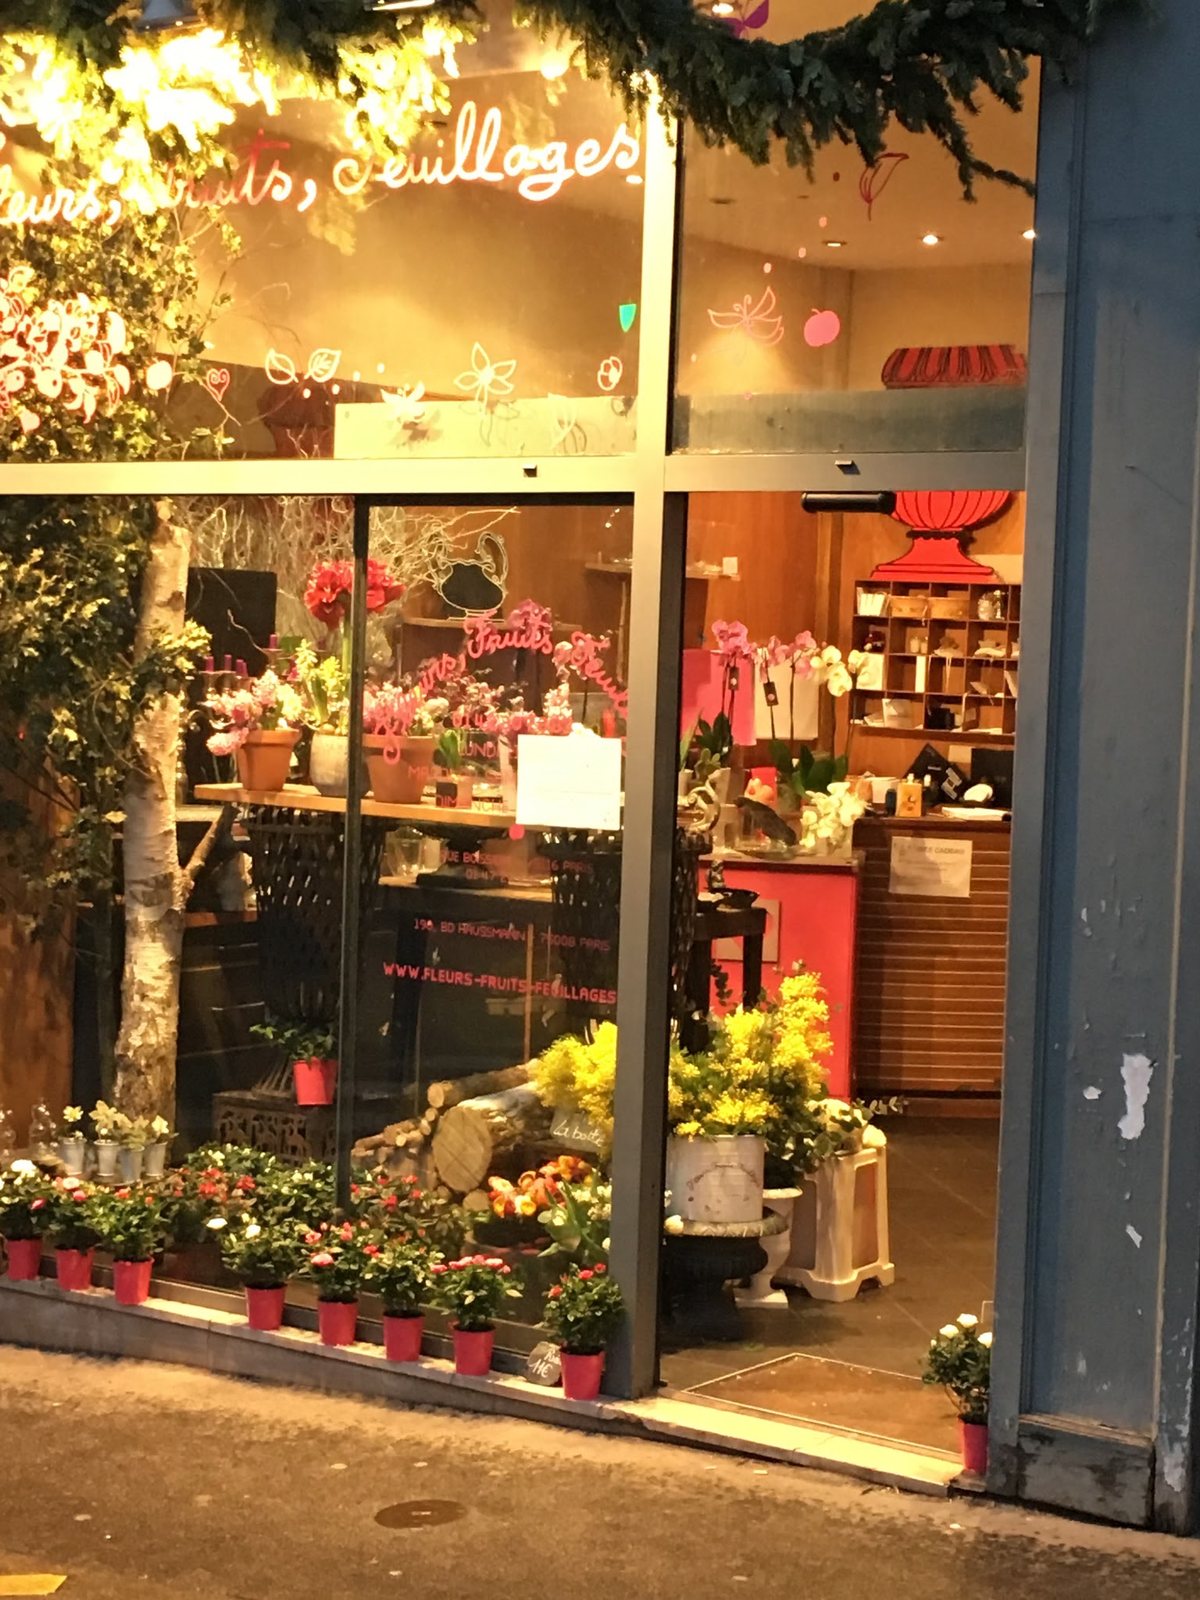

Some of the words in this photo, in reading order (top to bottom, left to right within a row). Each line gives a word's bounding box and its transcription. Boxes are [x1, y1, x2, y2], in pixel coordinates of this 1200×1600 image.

[464, 609, 553, 659] Fruits
[440, 921, 455, 933] BD
[458, 922, 525, 941] HAUSSMANN
[579, 936, 610, 951] PARIS
